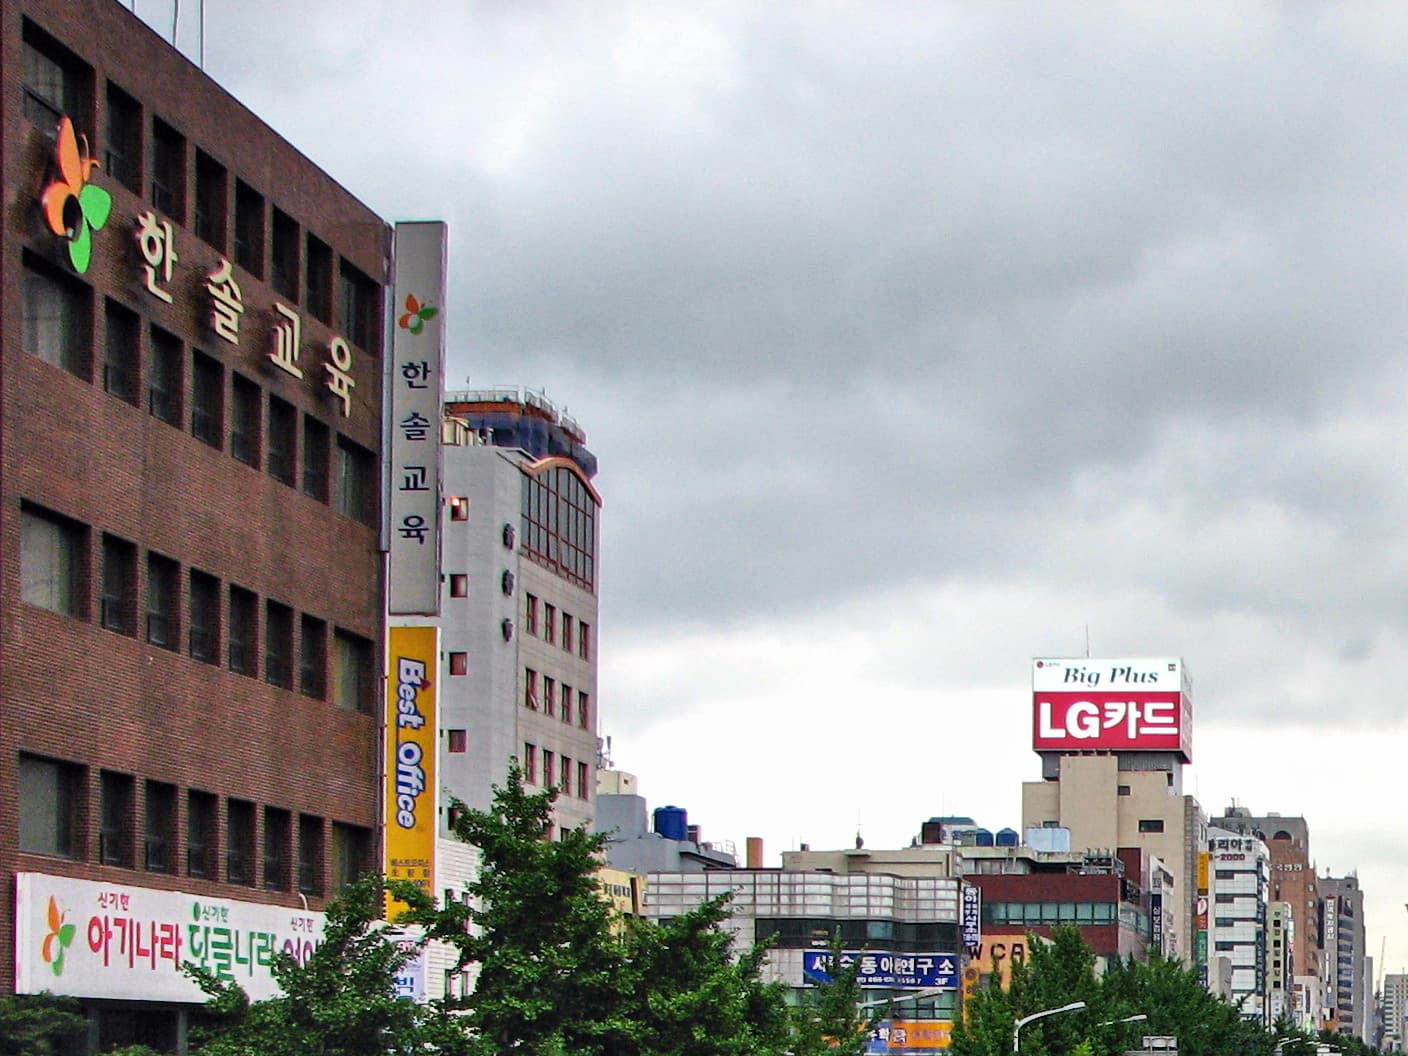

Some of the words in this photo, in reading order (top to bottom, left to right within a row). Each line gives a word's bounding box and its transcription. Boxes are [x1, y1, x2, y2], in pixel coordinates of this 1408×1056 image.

[134, 211, 355, 418] 한솔교육
[397, 360, 432, 545] 한솔교육
[397, 656, 427, 730] Best
[1063, 666, 1101, 688] Big
[1109, 666, 1160, 684] Plus
[1039, 701, 1179, 740] LG카드
[397, 740, 427, 829] Office
[98, 892, 129, 911] 신기한
[202, 905, 229, 923] 신기한
[87, 915, 183, 971] 아기나라
[188, 922, 276, 982] 한글나라
